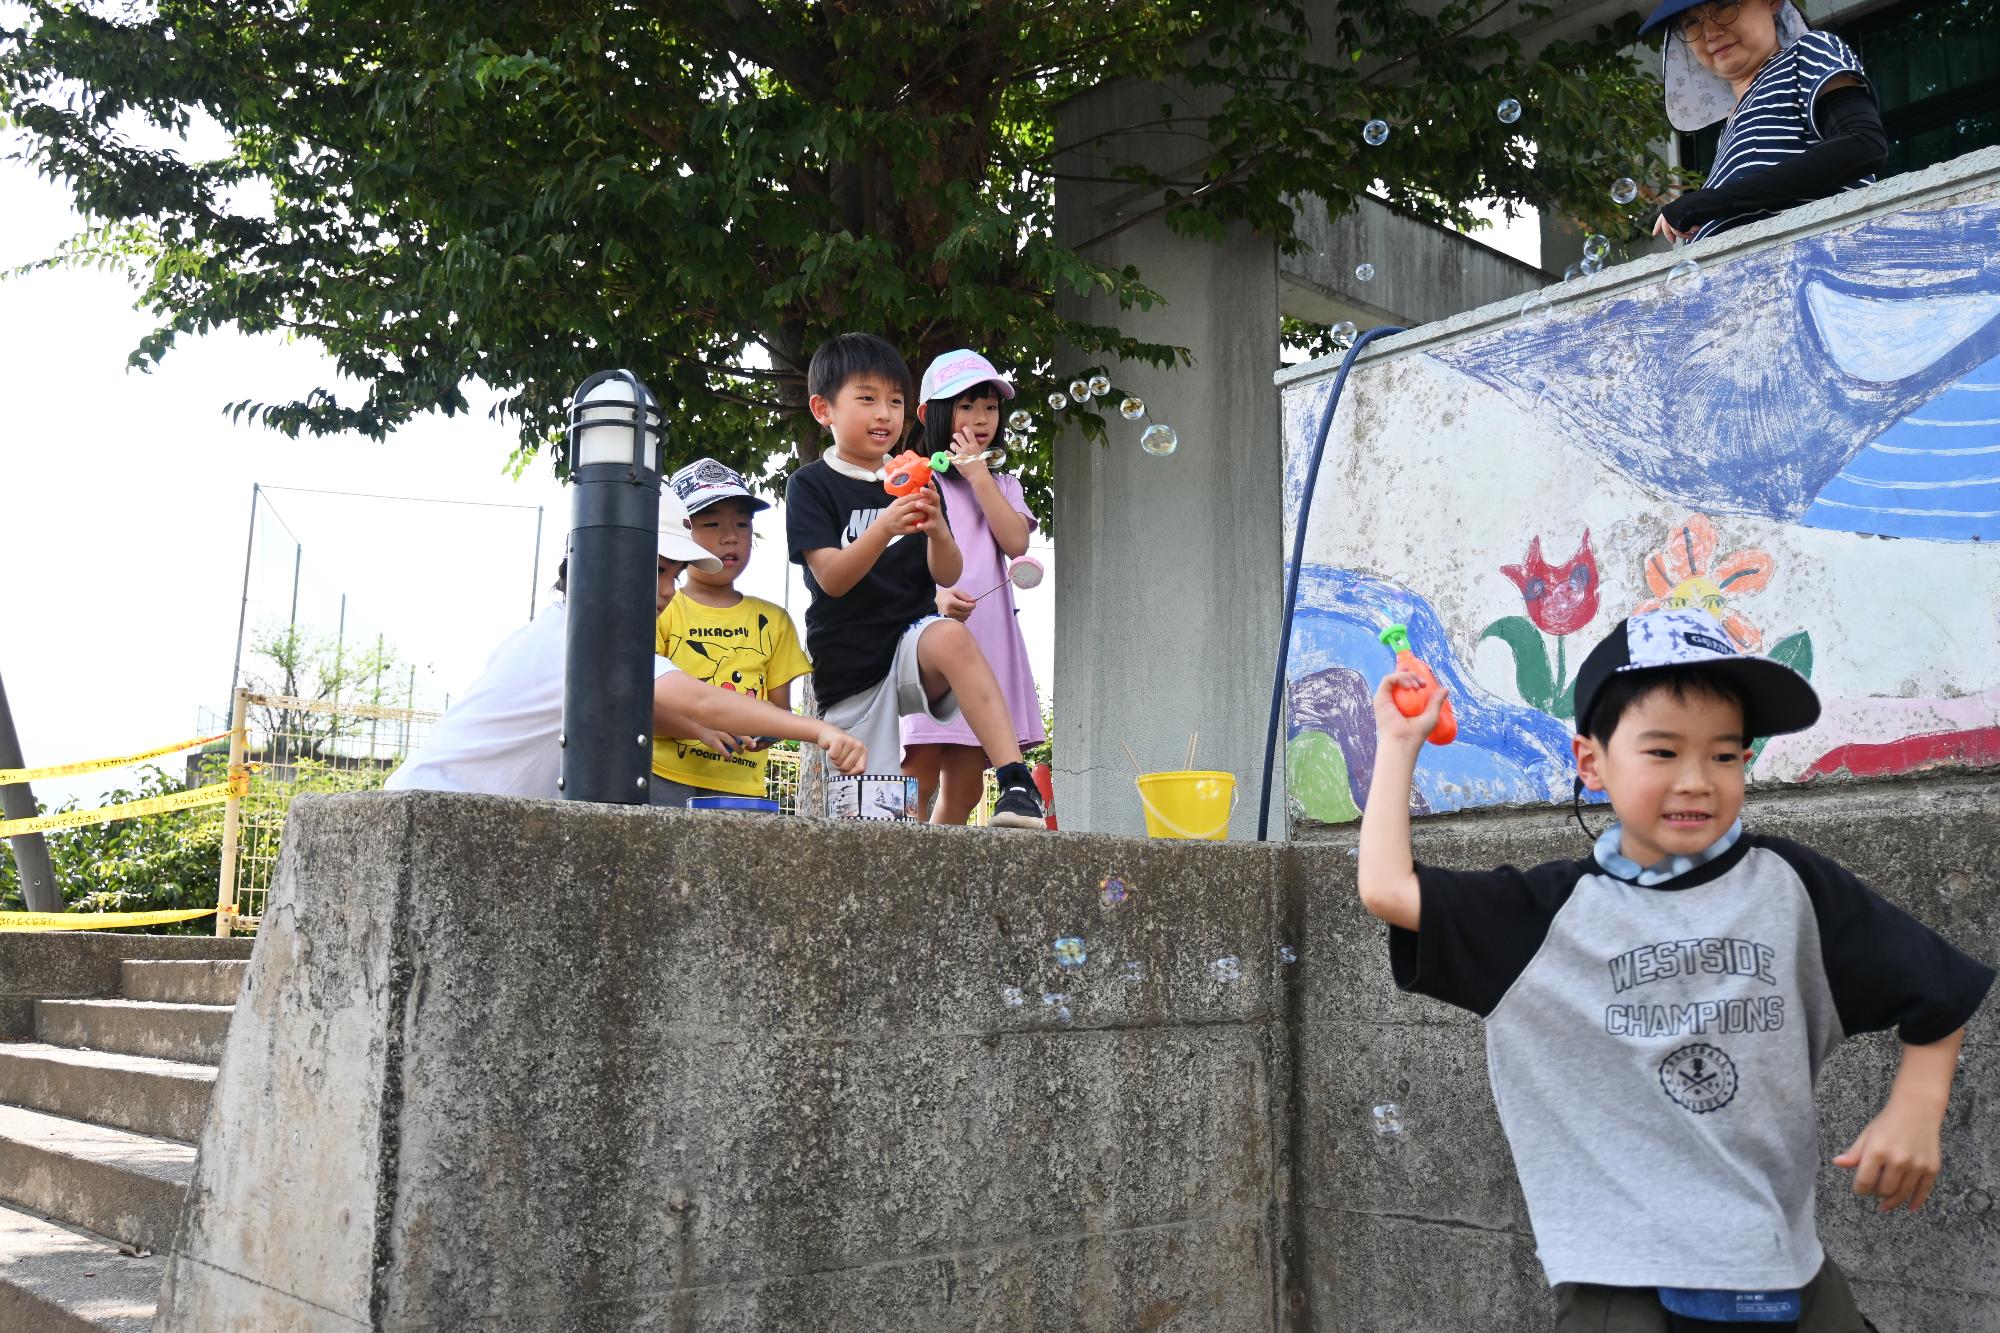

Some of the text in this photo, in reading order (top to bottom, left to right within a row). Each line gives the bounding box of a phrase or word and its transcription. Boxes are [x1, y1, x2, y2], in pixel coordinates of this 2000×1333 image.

[26, 814, 101, 832] 入らないでください
[1608, 938, 1776, 993] WESTSIDE
[1605, 996, 1784, 1037] CHAMPIONS
